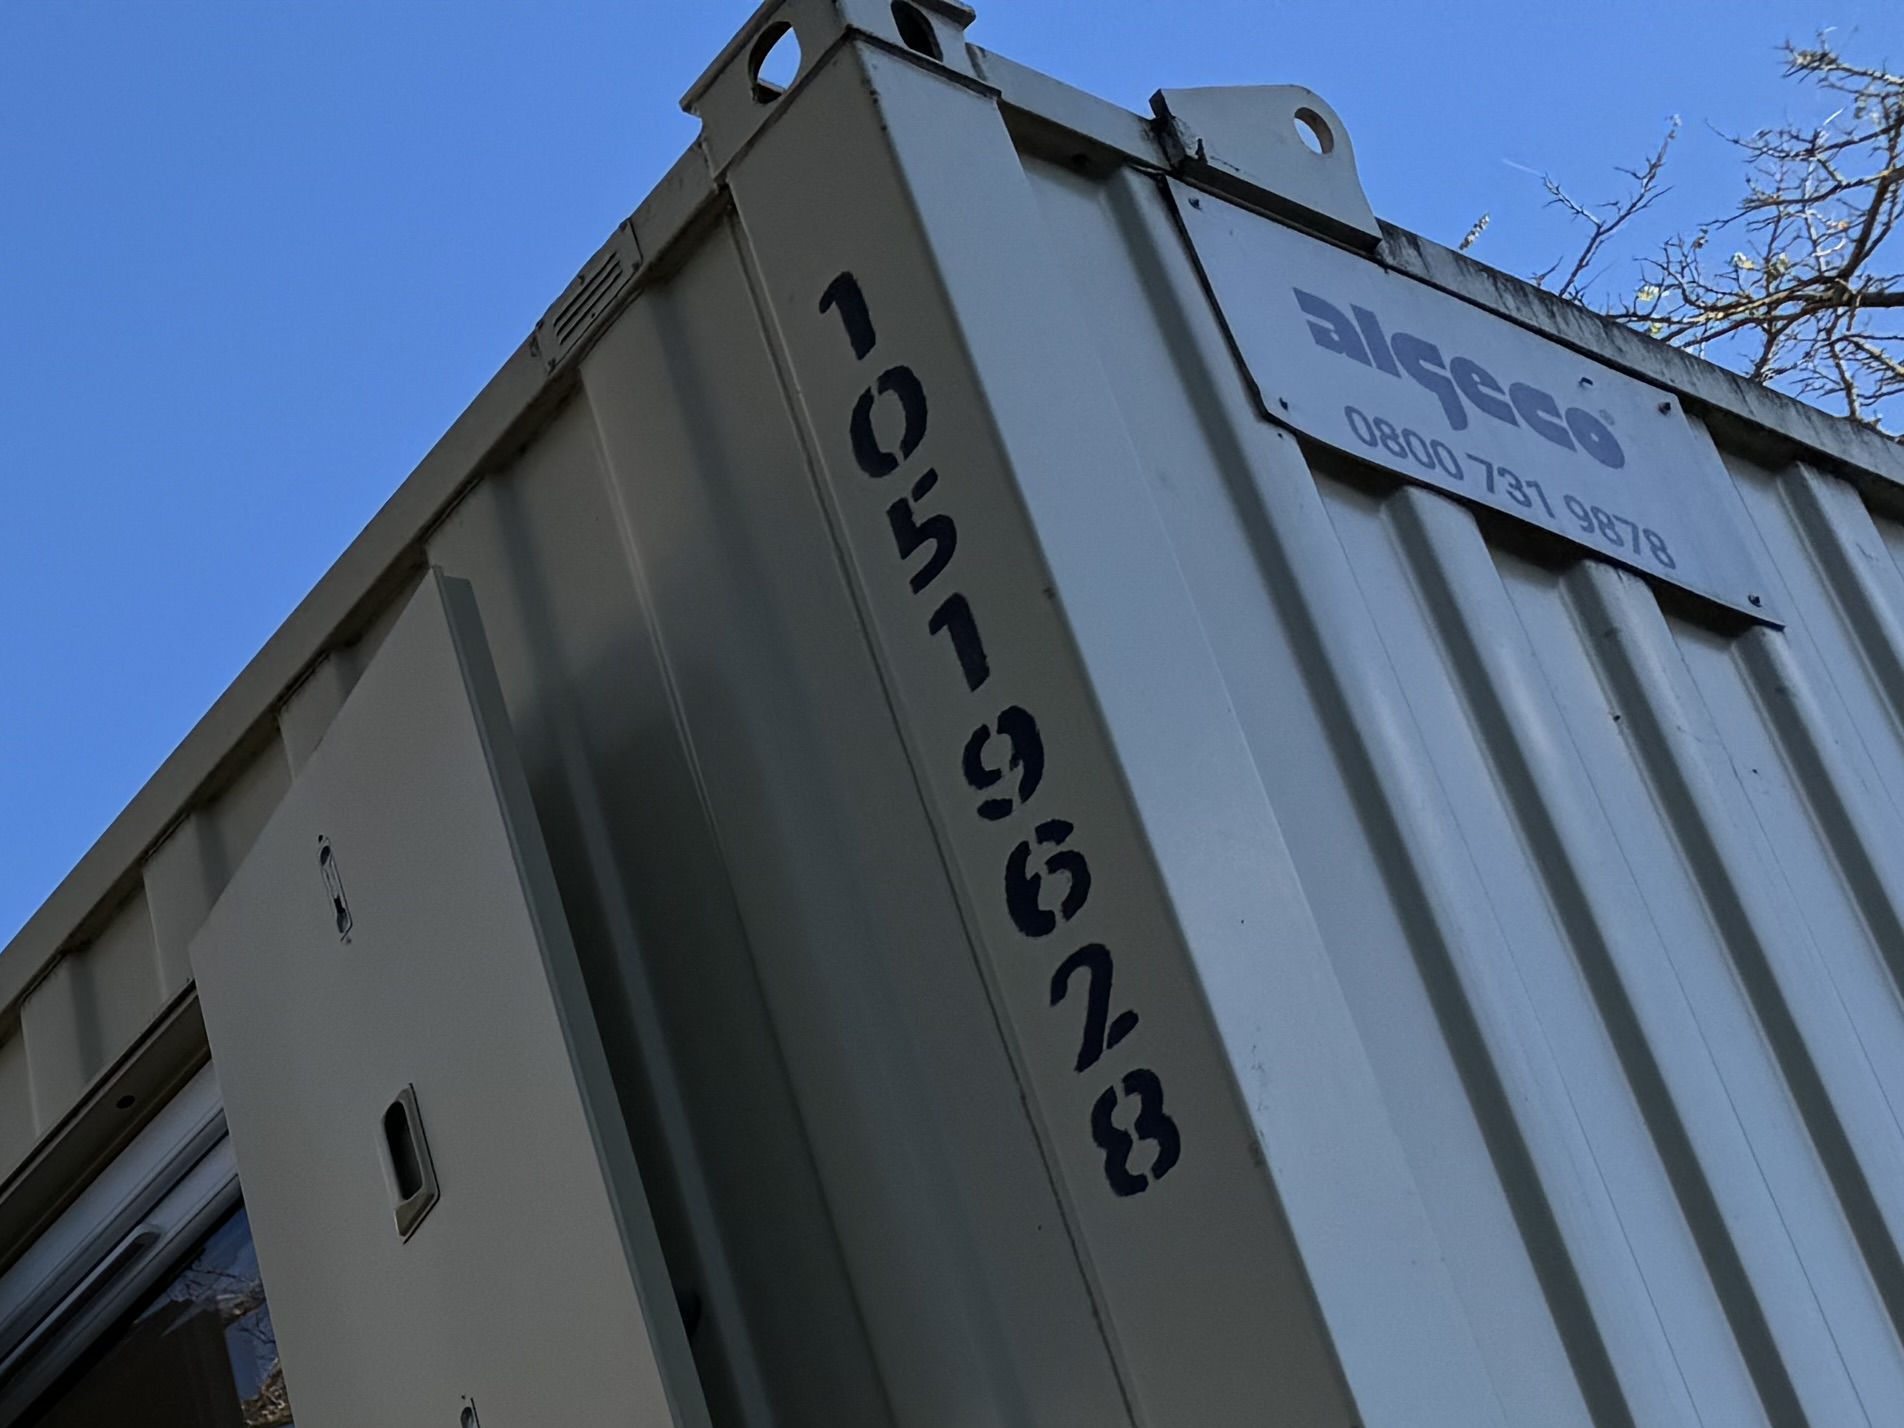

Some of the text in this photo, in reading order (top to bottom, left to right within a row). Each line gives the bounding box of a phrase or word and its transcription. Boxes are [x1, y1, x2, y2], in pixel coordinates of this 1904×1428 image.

[817, 270, 1181, 1198] 10519628
[1344, 405, 1676, 570] 0800 731 9878
